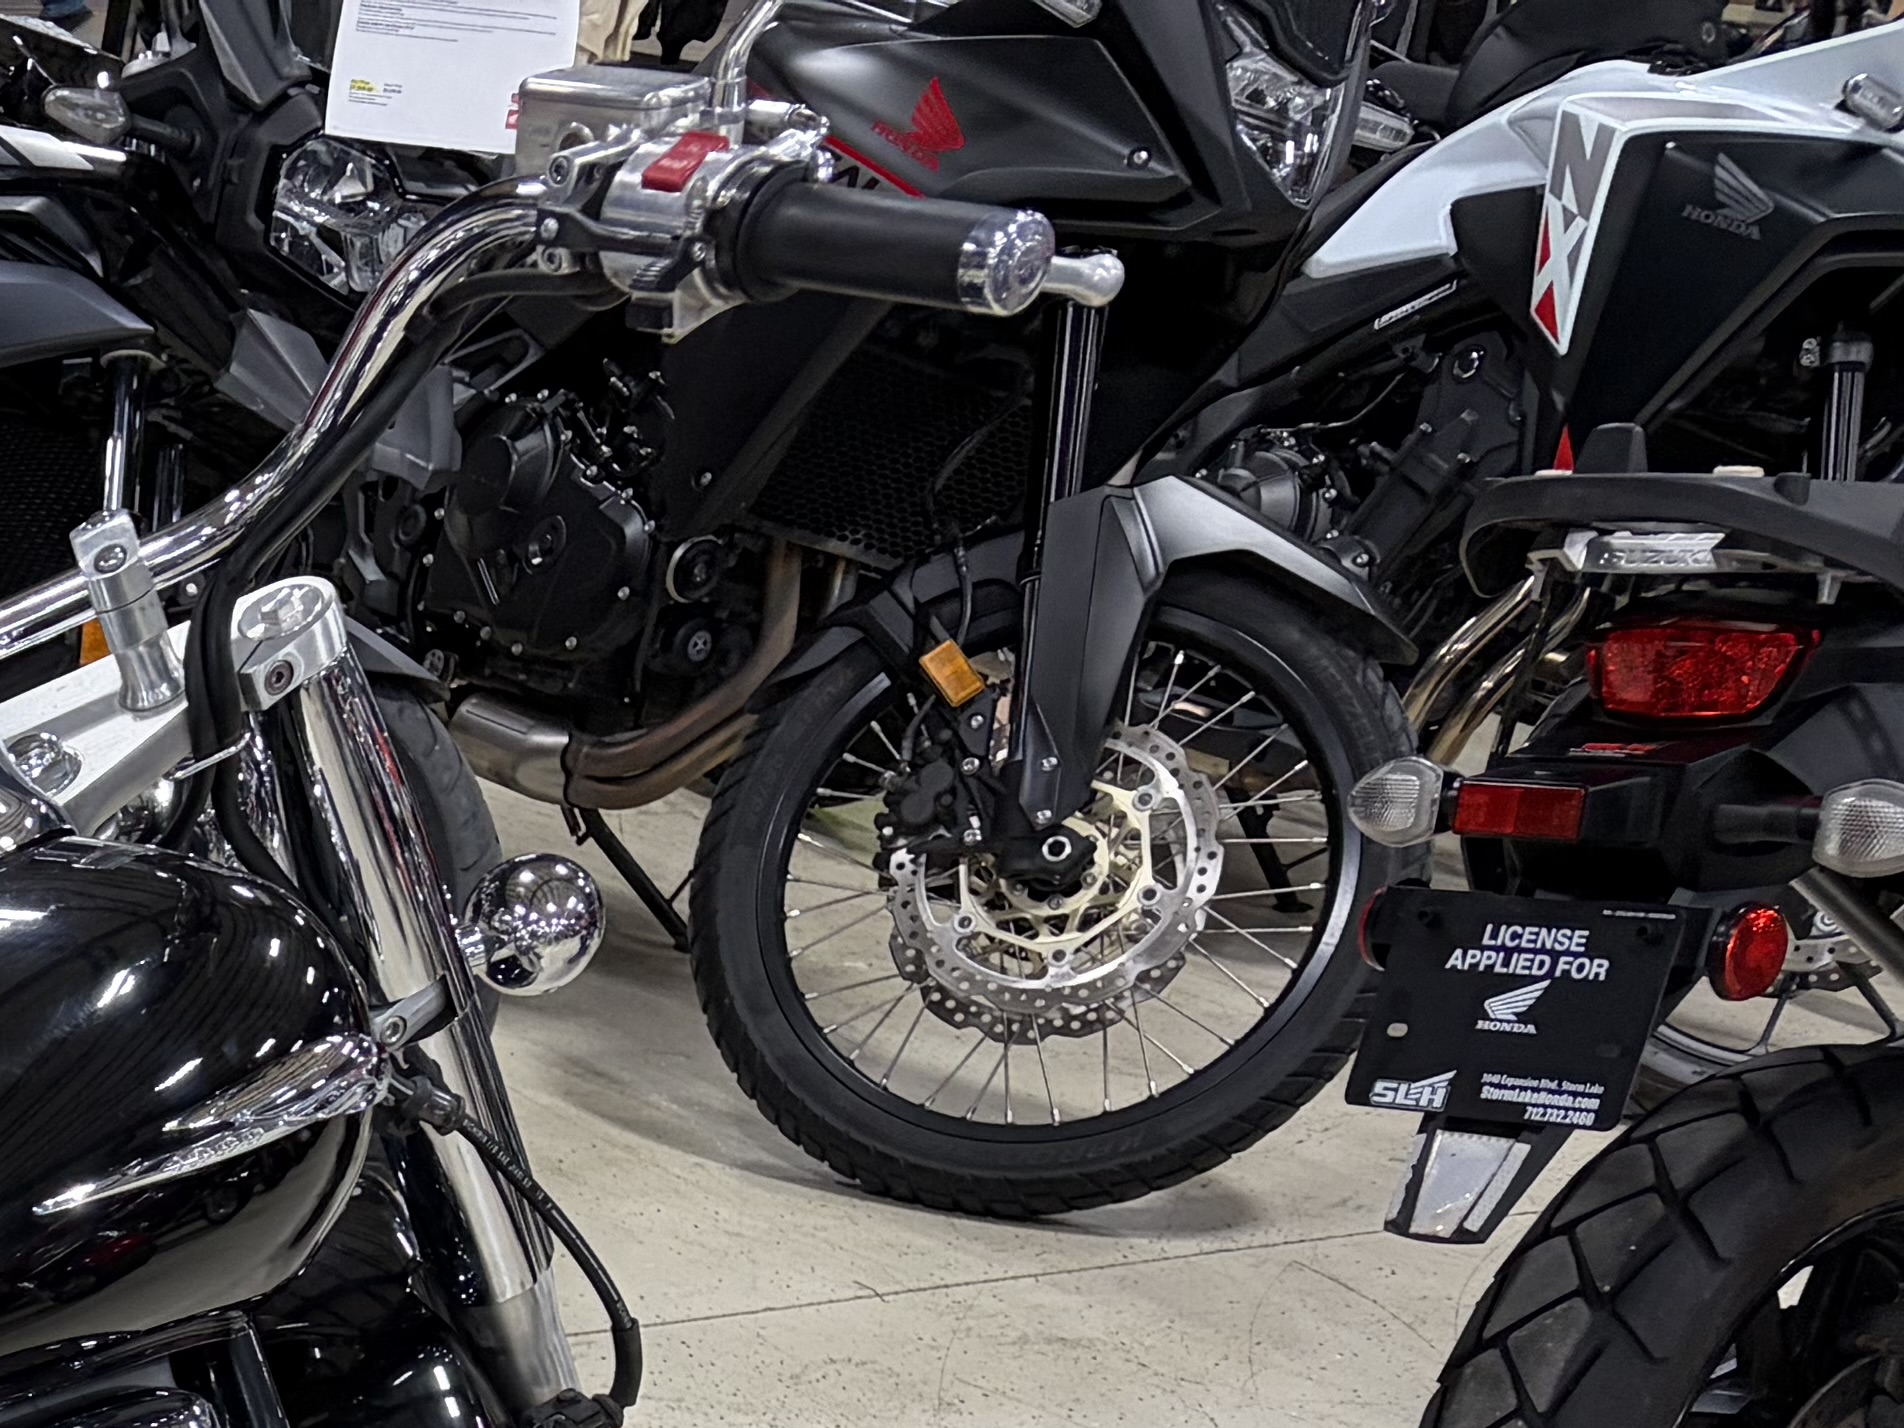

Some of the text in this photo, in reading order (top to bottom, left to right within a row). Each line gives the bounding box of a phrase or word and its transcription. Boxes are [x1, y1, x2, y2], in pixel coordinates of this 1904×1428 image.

[1681, 204, 1761, 241] HONDA
[1481, 923, 1590, 953] LICENSE
[1444, 948, 1611, 982] APPLIED FOR
[1474, 1019, 1537, 1035] HONDA
[1479, 1085, 1601, 1111] StormLakeHonda.com
